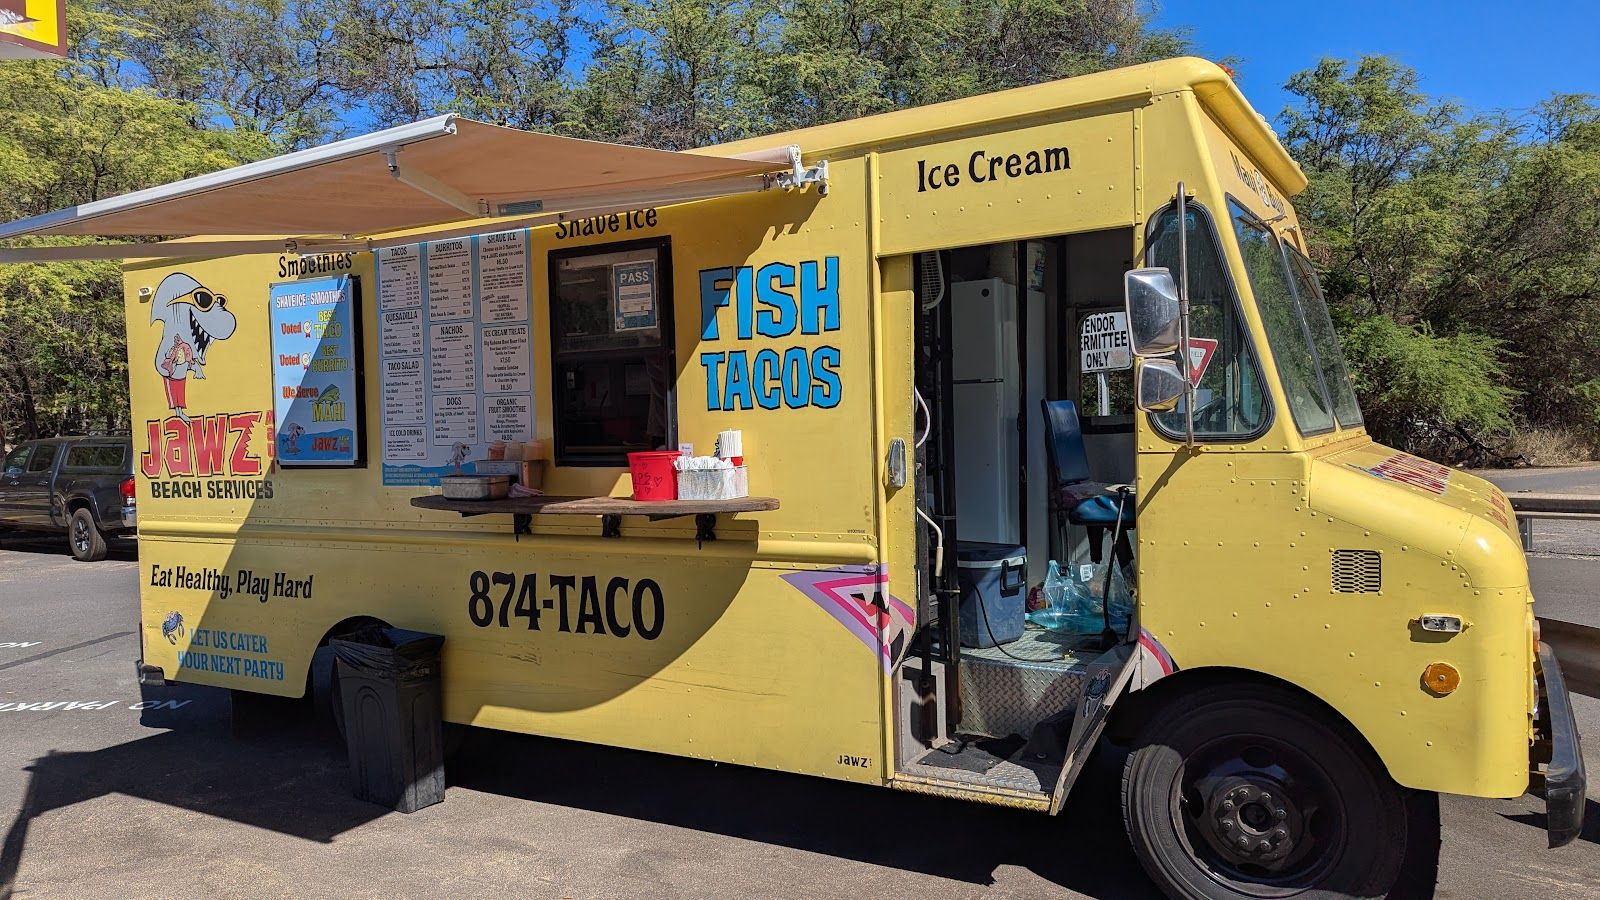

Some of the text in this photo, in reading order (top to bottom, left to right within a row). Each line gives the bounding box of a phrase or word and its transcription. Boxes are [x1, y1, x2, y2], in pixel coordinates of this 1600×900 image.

[918, 147, 1071, 192] Ice Cream
[625, 208, 658, 230] Ice
[391, 247, 408, 257] TACOS
[435, 241, 463, 253] BURRITOS
[278, 252, 352, 278] Smoothies
[620, 271, 649, 284] PASS
[276, 290, 346, 308] SHAVE ICE SMOOTHIES
[699, 256, 840, 342] FISH
[318, 310, 336, 322] BEST
[386, 311, 418, 323] QUESADILLA
[281, 322, 342, 339] Voted TACO
[440, 326, 463, 335] NACHOS
[280, 354, 348, 373] Voted BURRITO
[388, 361, 419, 370] TACO SALAD
[1086, 352, 1108, 368] ONLY
[700, 345, 842, 412] TACOS
[282, 385, 319, 399] We Serve
[446, 397, 462, 406] DOGS
[312, 401, 346, 423] MAHI
[152, 480, 274, 500] BEACH SERVICES
[151, 564, 314, 603] Eat Healthy, Play Hard
[468, 570, 664, 640] 874-TACO
[190, 628, 268, 654] LET US CATER
[178, 650, 284, 680] YOUR NEXT PARTY
[128, 700, 192, 710] NO
